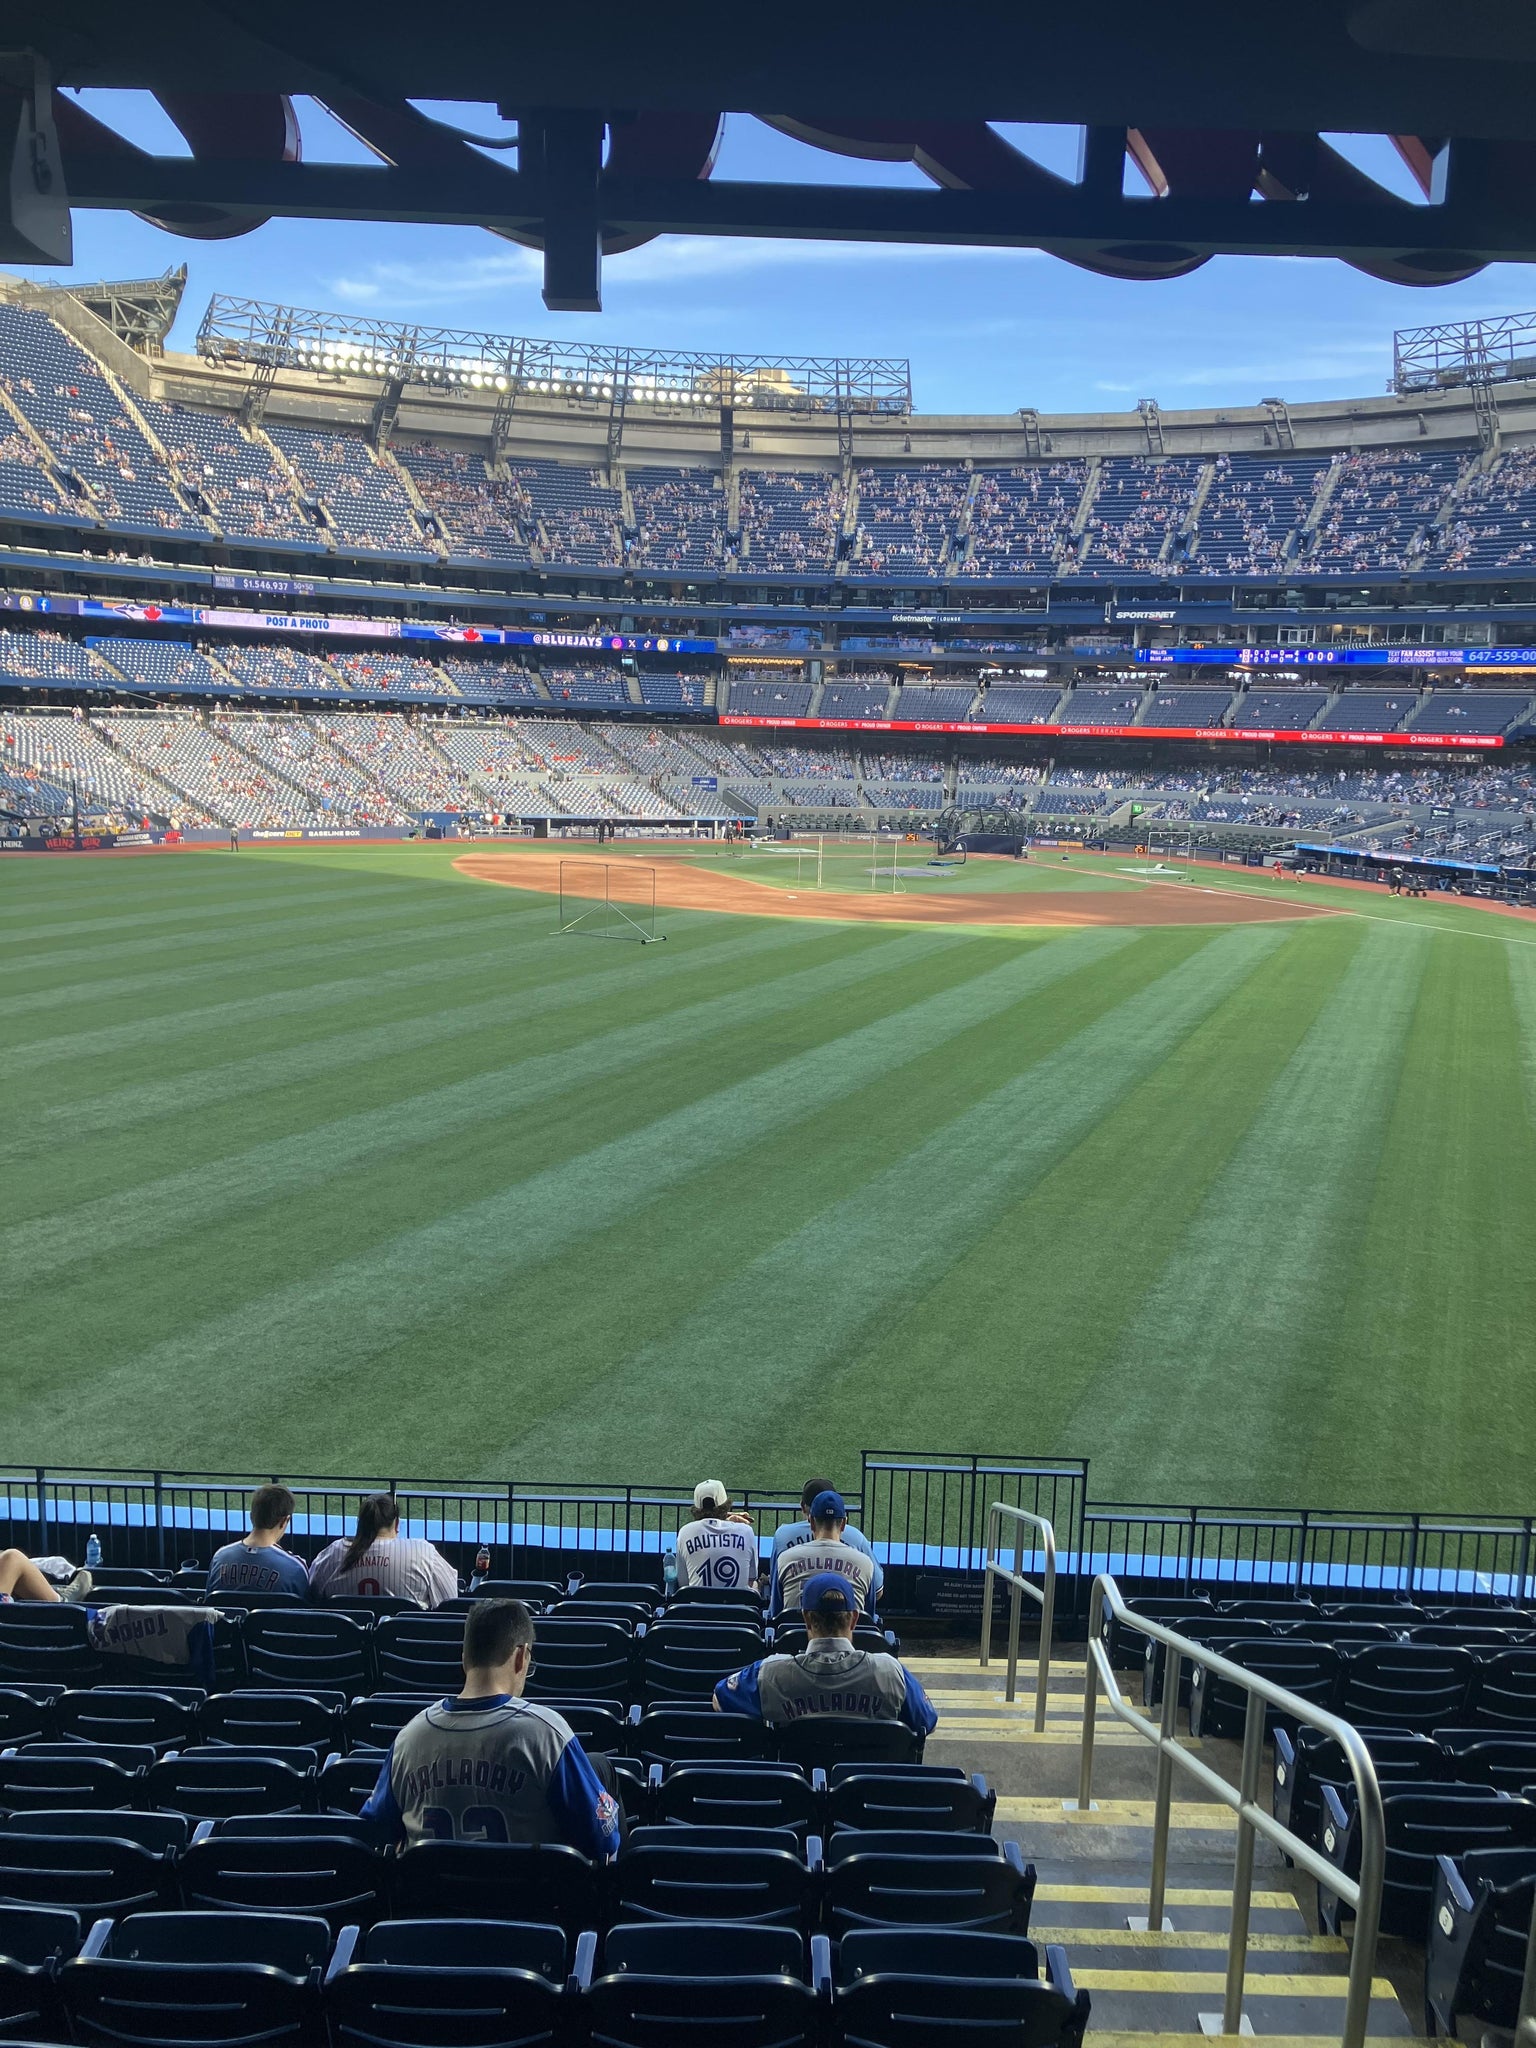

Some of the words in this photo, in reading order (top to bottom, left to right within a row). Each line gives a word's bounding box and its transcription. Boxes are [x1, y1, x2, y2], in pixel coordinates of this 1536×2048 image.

[266, 616, 288, 626] POST
[291, 618, 297, 627] A
[300, 618, 329, 629] PHOTO
[892, 614, 933, 622] ticketmaster
[1116, 611, 1176, 619] SPORTSNET
[533, 634, 602, 647] @BLUEJAYS
[1308, 652, 1313, 661] 0
[1318, 652, 1323, 661] 0
[1327, 652, 1333, 661] 0
[45, 838, 75, 849] HEINZ
[686, 1533, 745, 1555] BAUTISTA
[220, 1563, 280, 1591] HARPER
[696, 1556, 740, 1588] 19
[789, 1557, 862, 1581] HALLADAY
[782, 1692, 882, 1720] HALLADAY
[407, 1757, 526, 1796] HALLADAY
